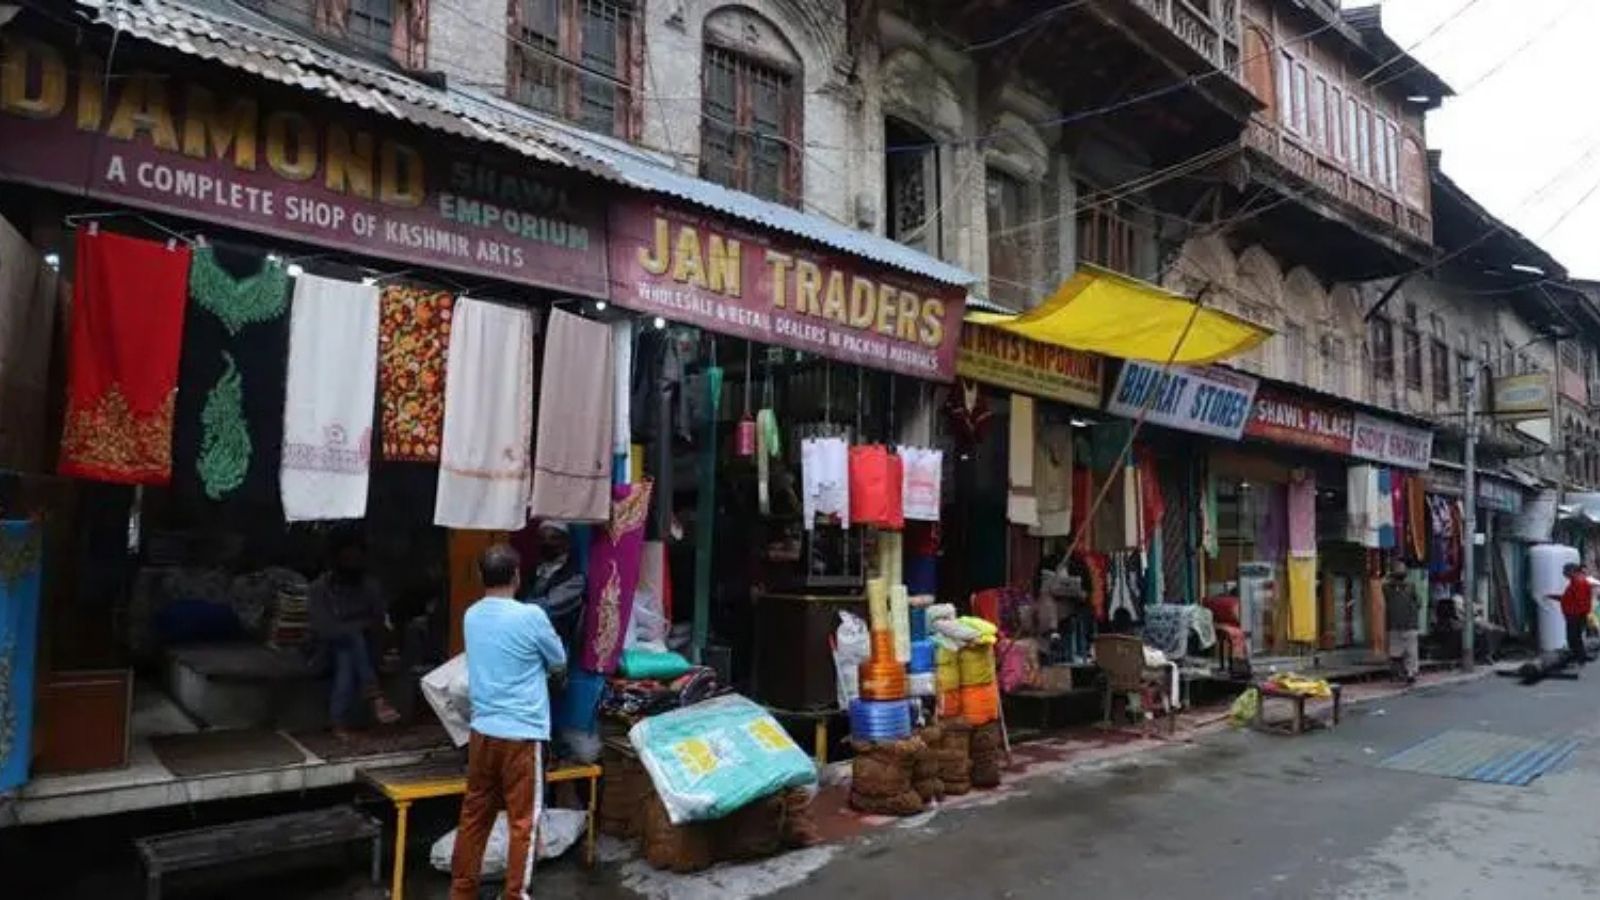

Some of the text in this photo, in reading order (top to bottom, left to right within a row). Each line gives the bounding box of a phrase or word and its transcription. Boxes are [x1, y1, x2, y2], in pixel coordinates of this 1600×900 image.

[0, 38, 428, 207] DIAMOND
[106, 155, 524, 268] A COMPLETE SHOP OF KASHMIR ARTS
[439, 193, 589, 250] EMPORIUM
[638, 217, 742, 298] JAN
[765, 250, 946, 347] TRADERS
[638, 281, 714, 316] WHOLESALE
[727, 306, 771, 331] RETAIL
[775, 317, 826, 344] DEALERS
[828, 331, 841, 347] IN
[843, 334, 888, 360] PACKING
[1117, 363, 1188, 416] BHARAT
[1190, 382, 1249, 430] STORES
[1256, 399, 1306, 429] SHAWL
